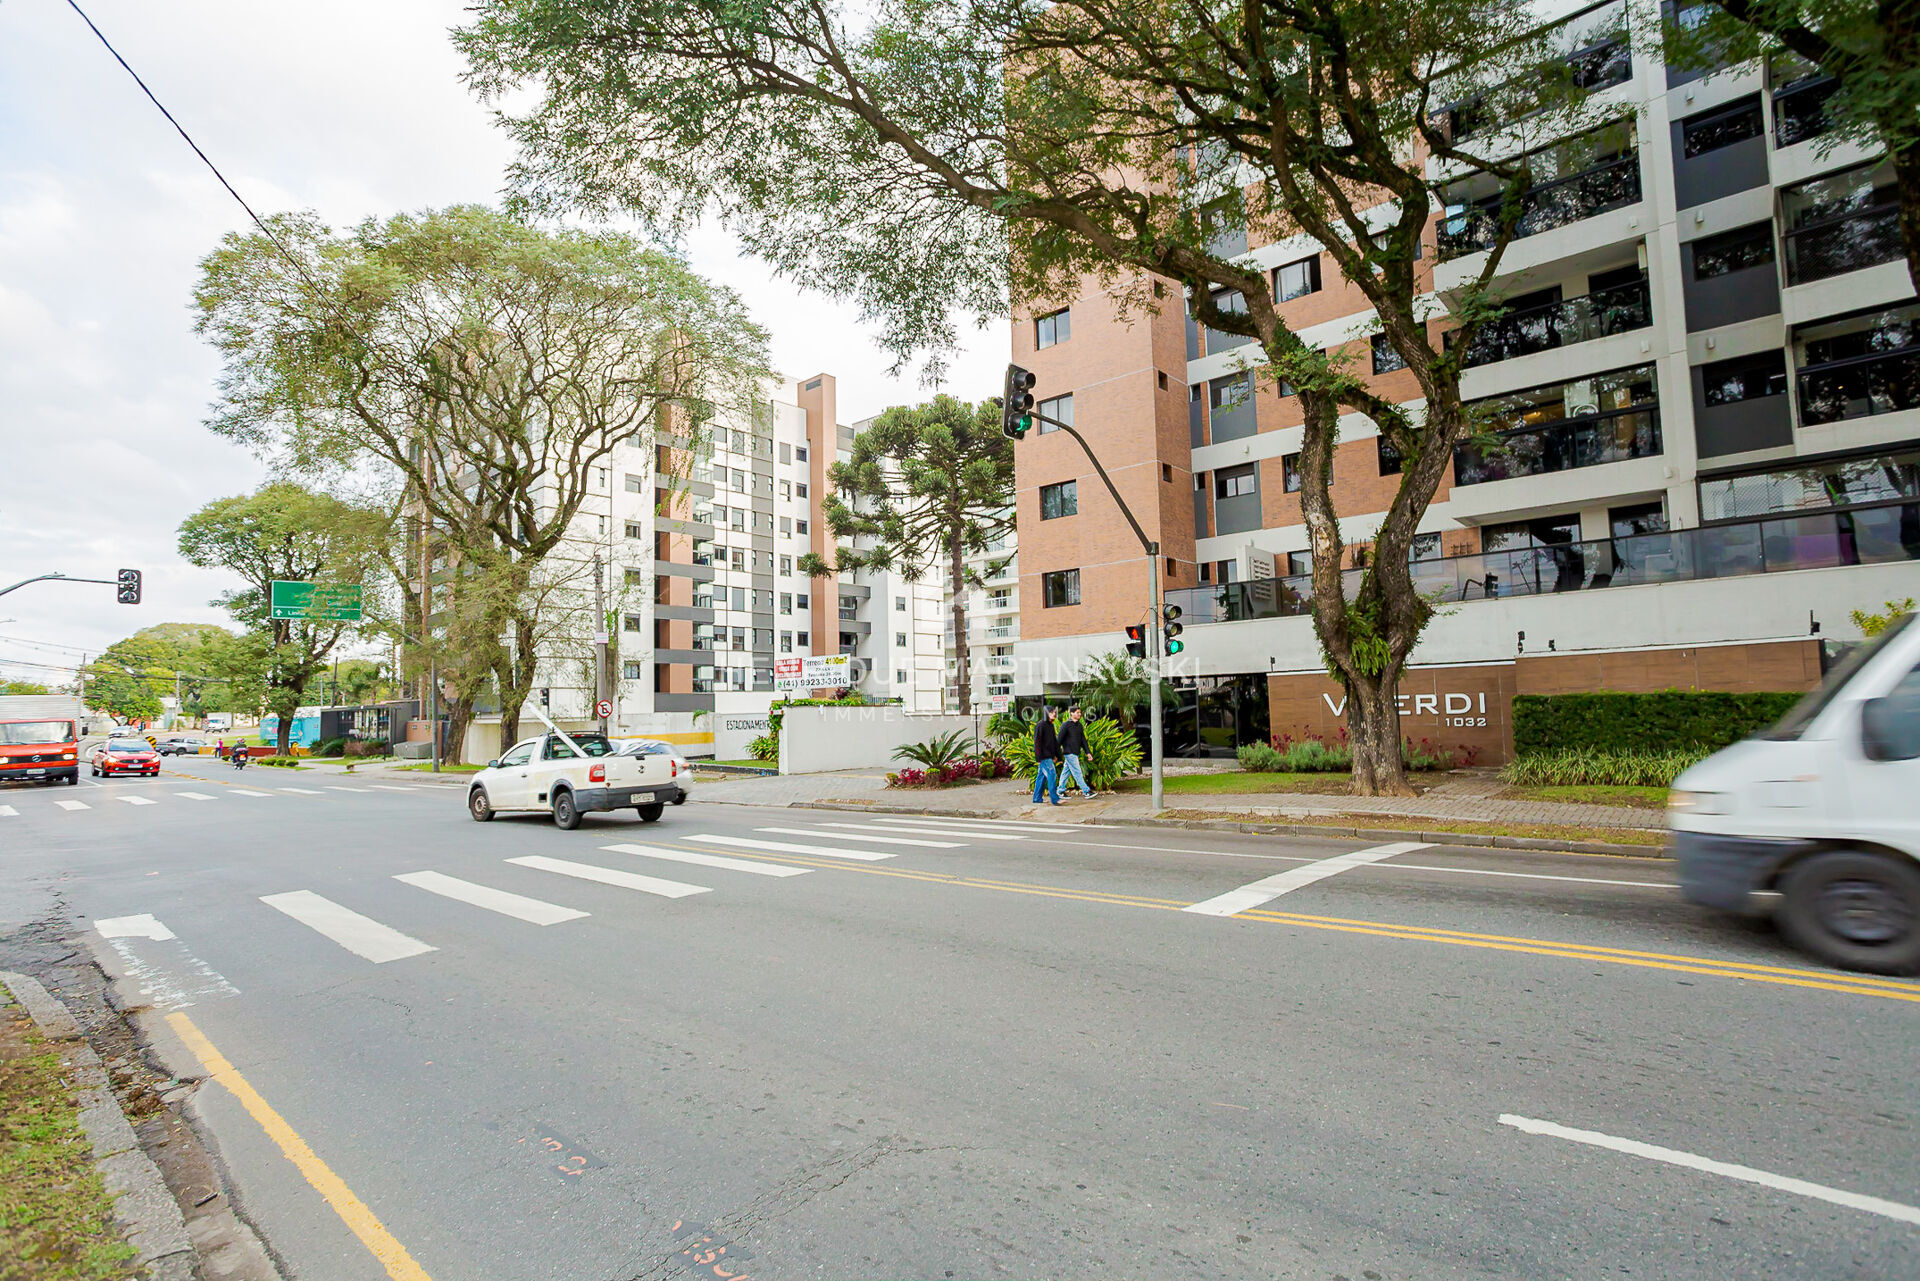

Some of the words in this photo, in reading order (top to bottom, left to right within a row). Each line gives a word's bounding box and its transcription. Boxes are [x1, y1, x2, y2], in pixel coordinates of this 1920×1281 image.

[783, 680, 798, 688] (41)
[726, 719, 772, 731] ESTACIONAMENT
[1445, 717, 1487, 727] 1032
